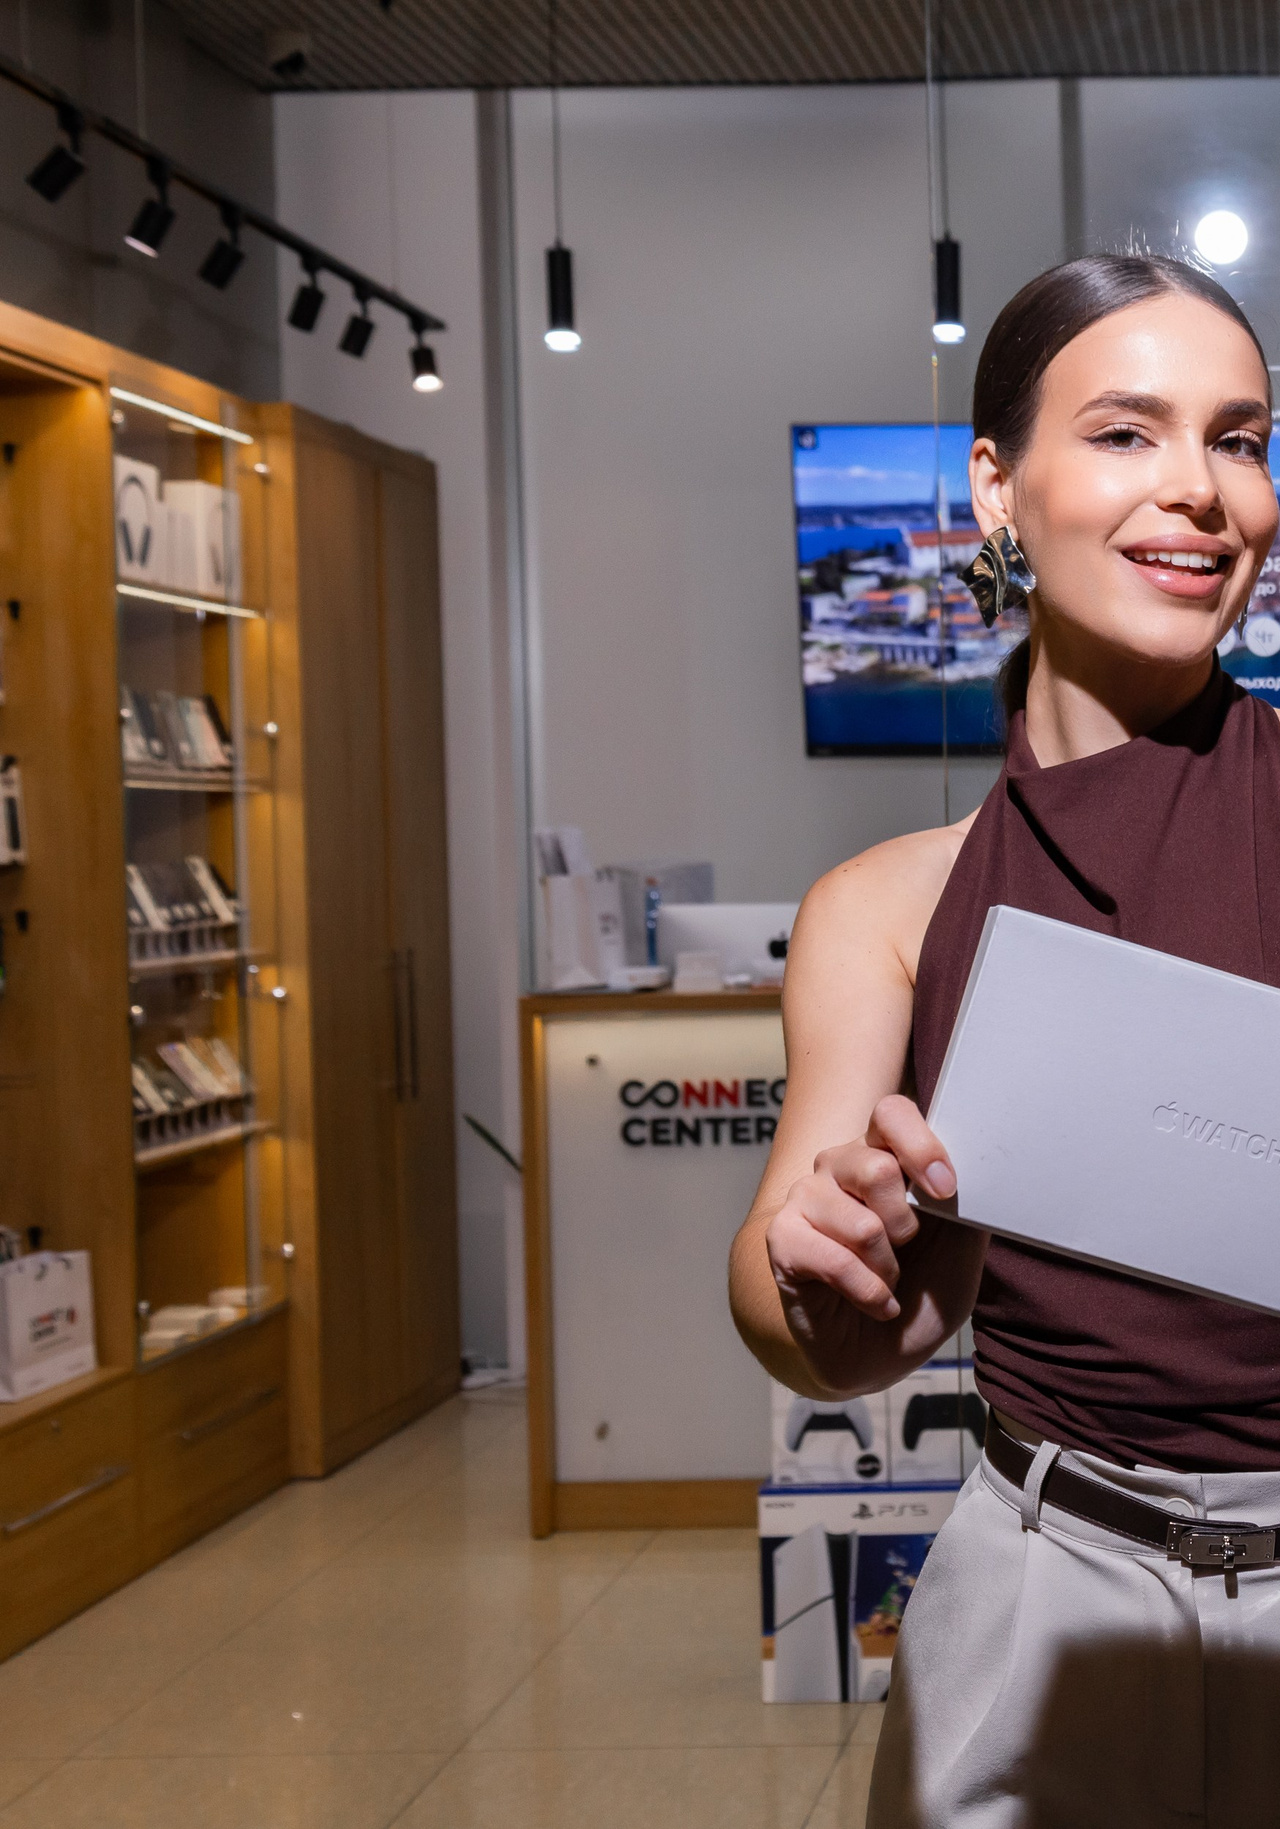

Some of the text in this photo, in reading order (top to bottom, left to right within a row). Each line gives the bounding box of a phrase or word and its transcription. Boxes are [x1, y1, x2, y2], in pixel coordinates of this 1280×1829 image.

[1255, 581, 1277, 597] до
[1255, 630, 1274, 644] Чт
[619, 1079, 787, 1109] CONNEC
